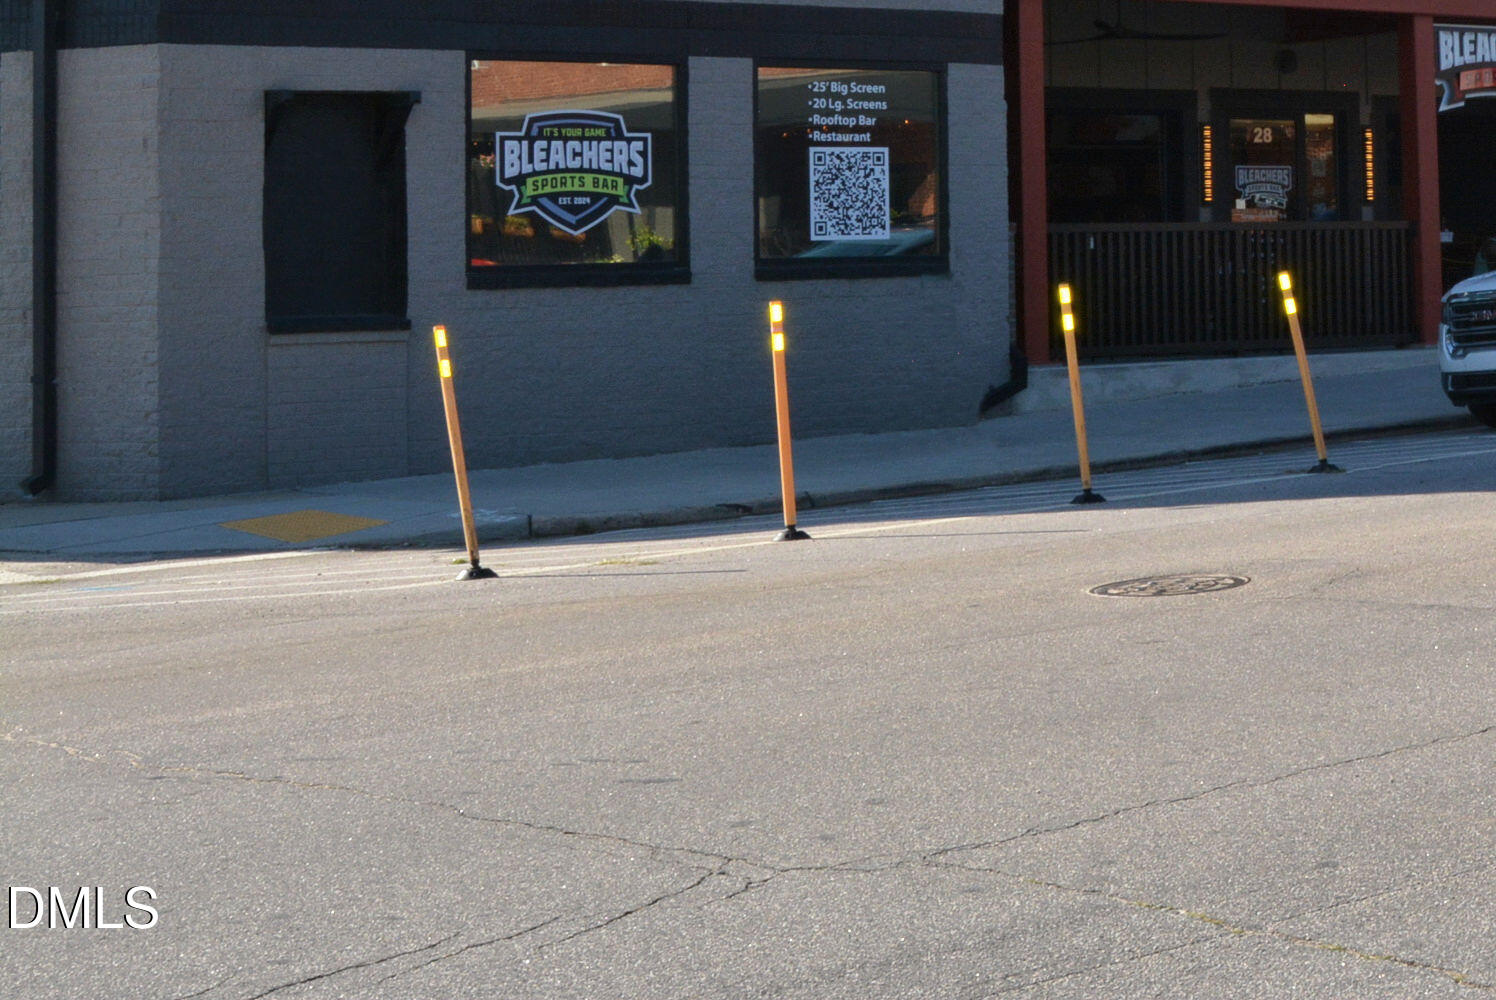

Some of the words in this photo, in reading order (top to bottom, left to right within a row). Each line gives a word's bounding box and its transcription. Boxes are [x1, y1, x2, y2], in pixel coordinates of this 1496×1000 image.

[830, 81, 848, 96] Big
[850, 82, 886, 94] Screen
[812, 98, 827, 109] 20
[828, 98, 845, 112] Lg.
[847, 98, 888, 110] Screens
[813, 114, 857, 128] Rooftop
[858, 115, 877, 126] Bar
[543, 127, 559, 137] IT'S
[561, 128, 583, 138] YOUR
[584, 128, 607, 138] GAME
[813, 131, 872, 143] Restaurant
[1253, 127, 1273, 144] 28
[504, 139, 644, 180] BLEACHERS
[532, 176, 586, 192] SPORTS
[592, 176, 619, 192] BAR
[1239, 168, 1289, 187] BLEACHERS
[558, 197, 572, 205] EST.
[573, 197, 591, 205] 2024
